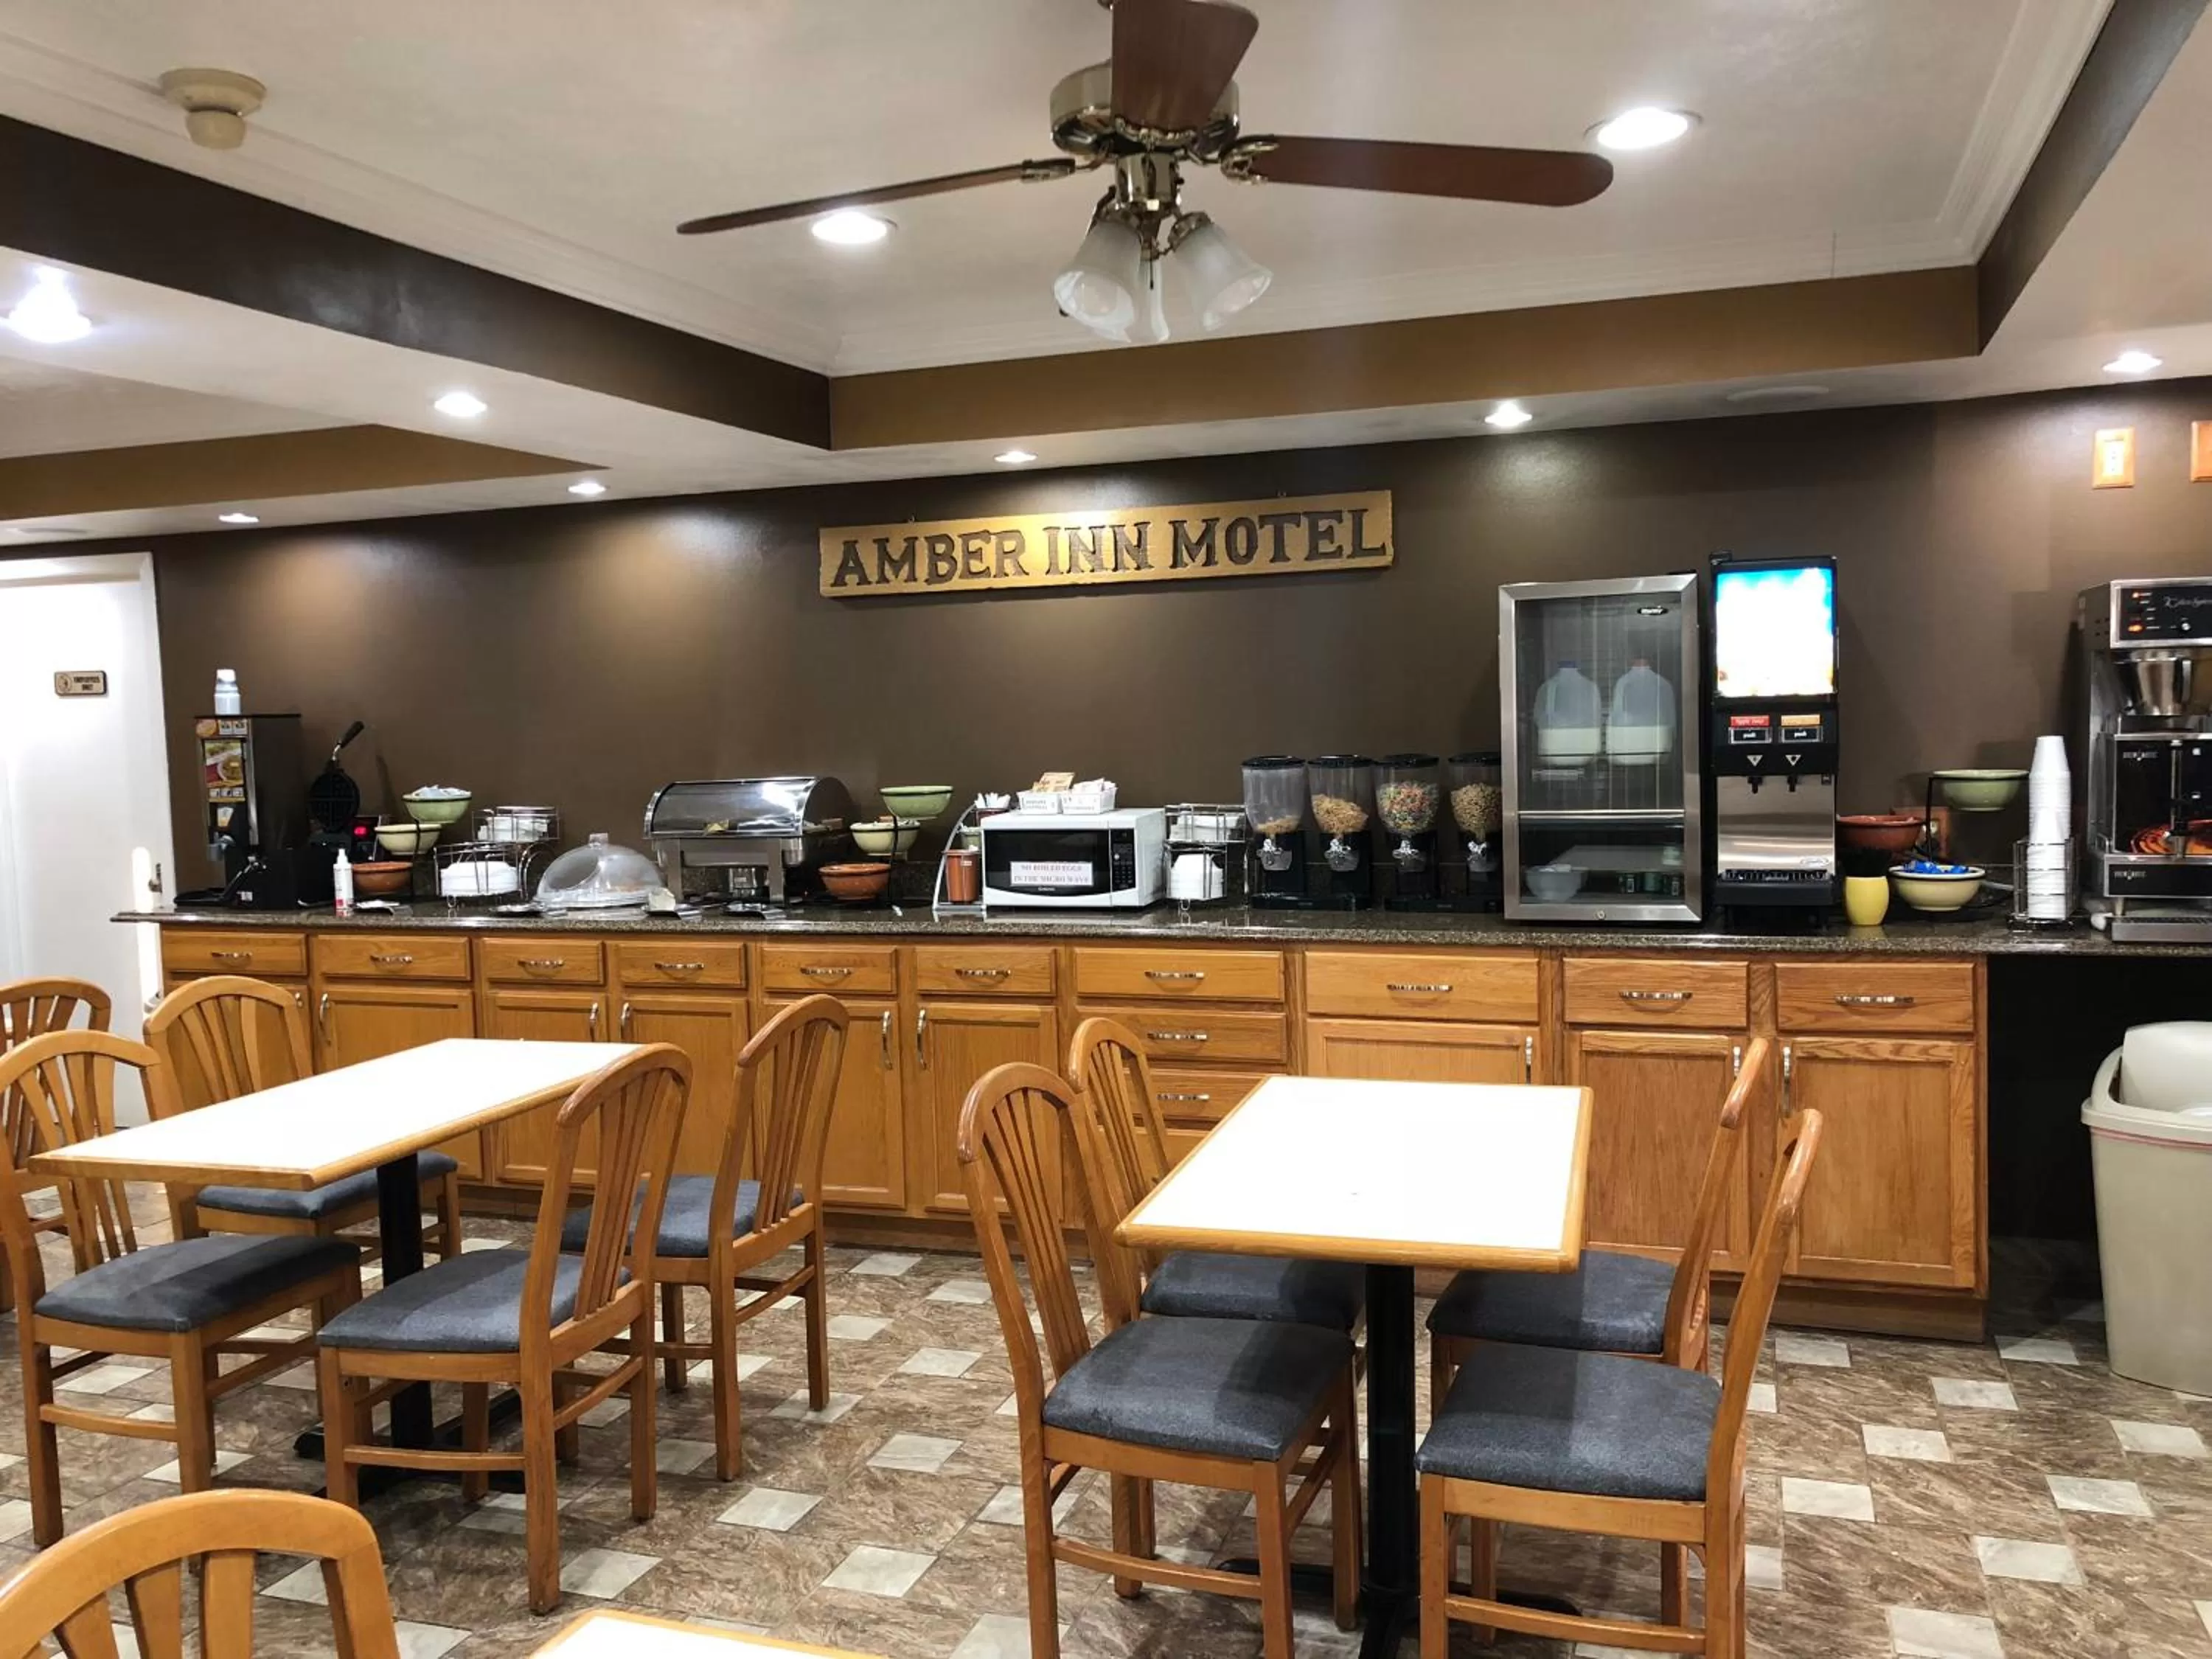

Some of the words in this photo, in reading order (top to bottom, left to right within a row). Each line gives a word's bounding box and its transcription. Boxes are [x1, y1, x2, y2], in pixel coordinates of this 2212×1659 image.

[832, 528, 1030, 588] AMBER
[1042, 520, 1155, 576] INN
[1168, 507, 1388, 570] MOTEL
